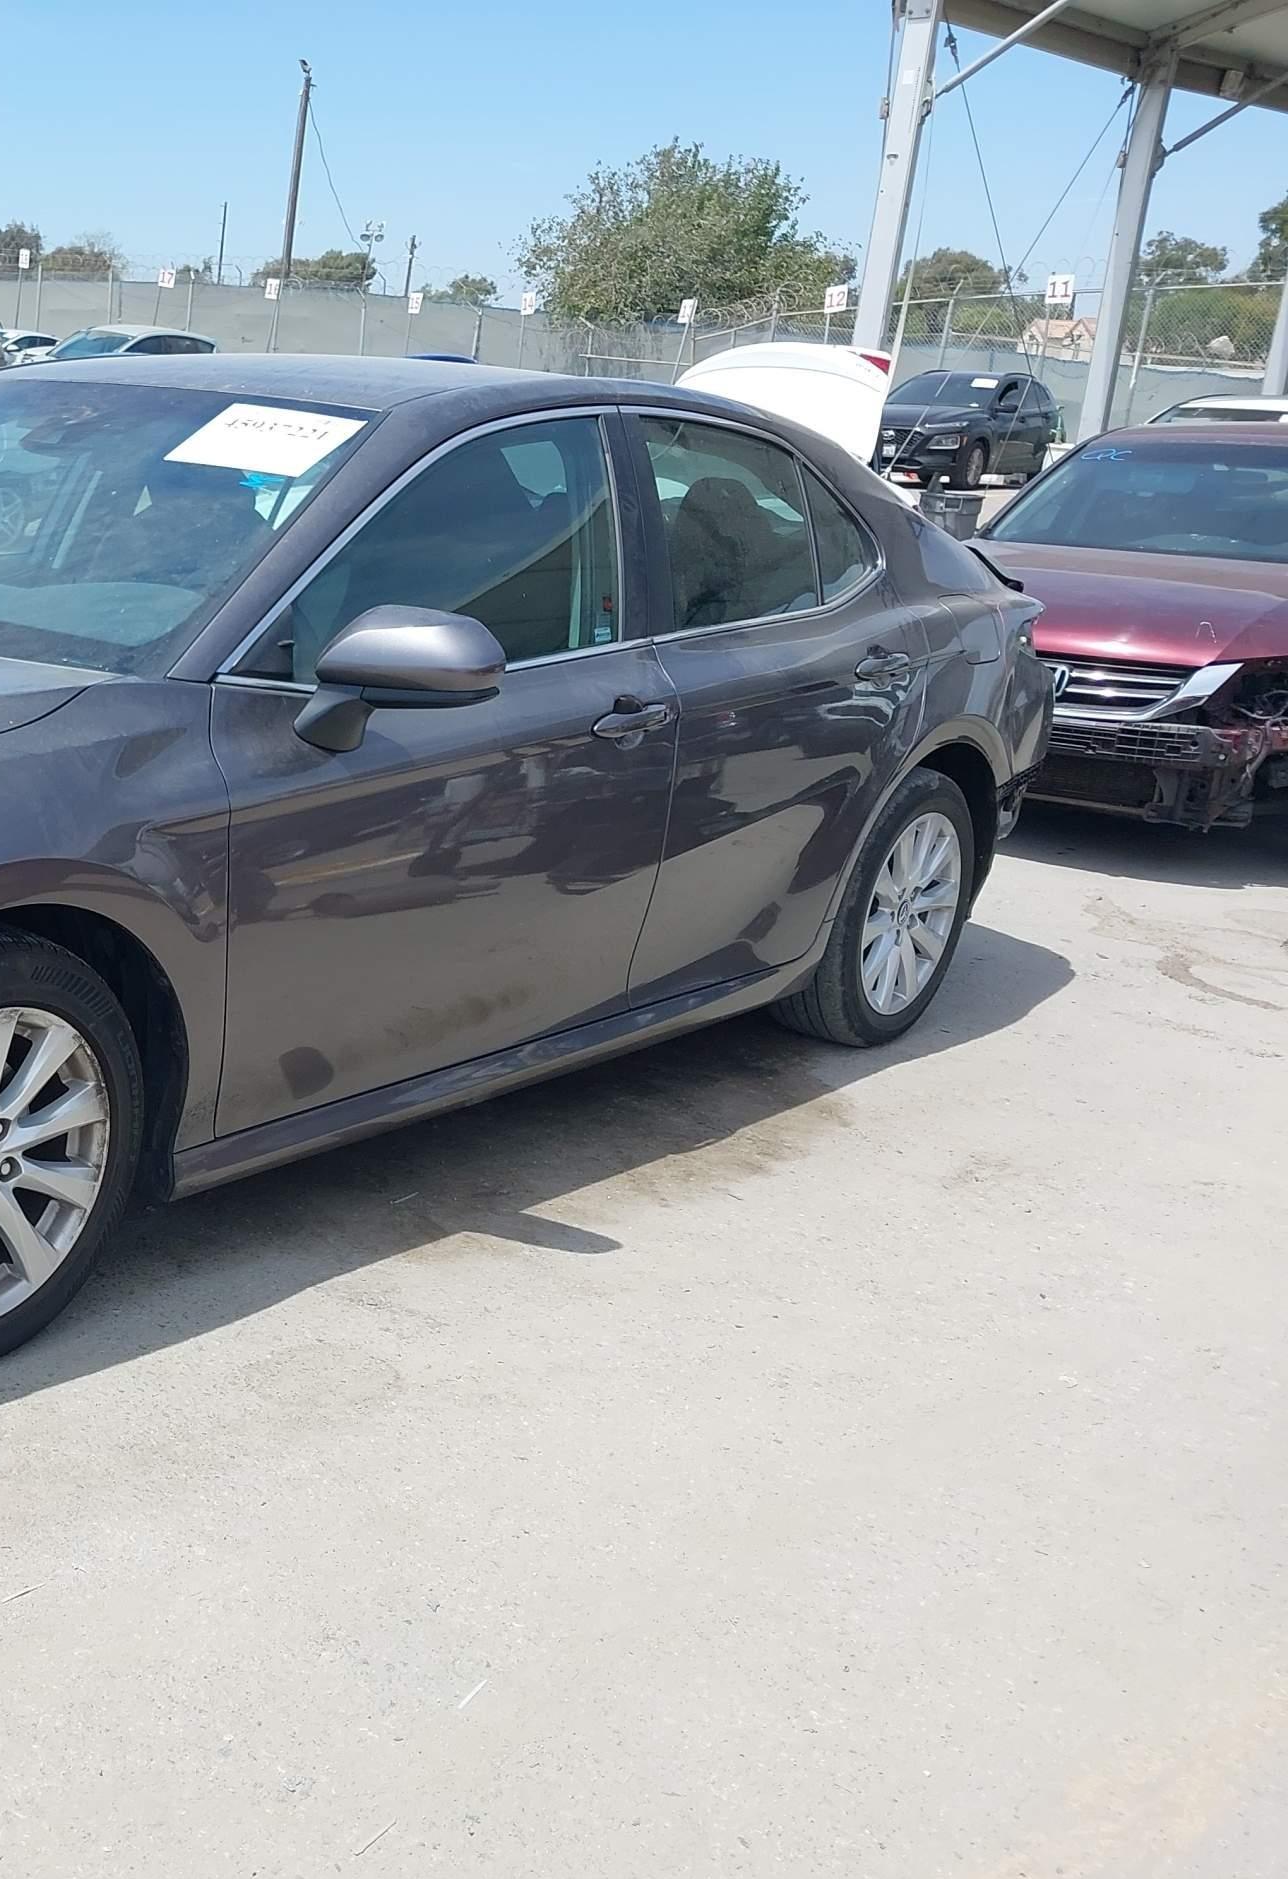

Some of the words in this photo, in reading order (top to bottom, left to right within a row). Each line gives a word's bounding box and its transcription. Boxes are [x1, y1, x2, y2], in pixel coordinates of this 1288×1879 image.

[160, 271, 174, 285] 17
[1048, 280, 1071, 299] 11
[410, 296, 421, 310] 15
[825, 291, 846, 308] 12
